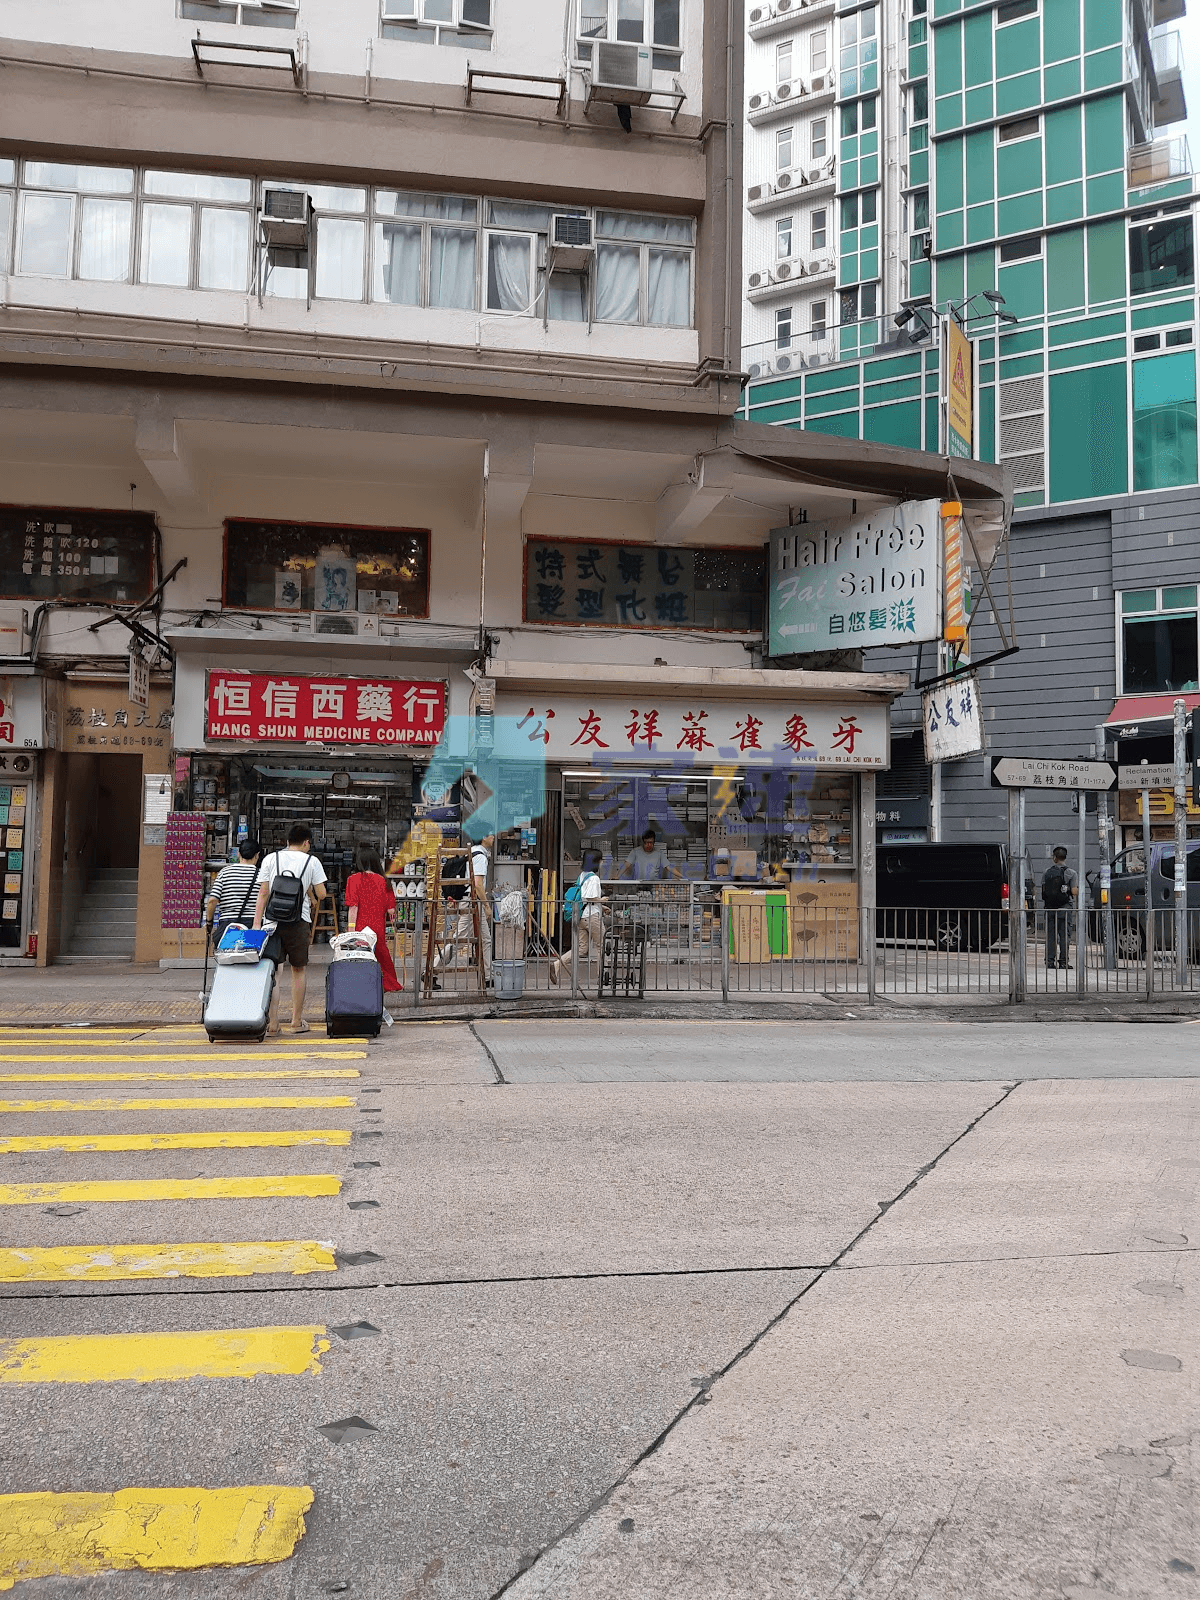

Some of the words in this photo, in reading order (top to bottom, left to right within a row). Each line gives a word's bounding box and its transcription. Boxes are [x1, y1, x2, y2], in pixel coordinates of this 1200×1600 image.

[76, 538, 99, 548] 120
[778, 530, 842, 570] Hair
[856, 523, 925, 559] Free
[59, 553, 81, 562] 100
[840, 568, 925, 597] Salon
[213, 679, 440, 724] 恒信西藥行
[928, 686, 973, 732] 公友祥
[211, 722, 250, 737] HANG
[258, 724, 297, 738] SHUN
[303, 726, 371, 740] MEDICINE
[376, 728, 443, 743] COMPANY
[24, 739, 38, 748] 65A
[1022, 762, 1035, 770] Lai
[1036, 762, 1050, 770] Chi
[1051, 762, 1066, 771] Kok
[1068, 763, 1090, 772] Road
[1125, 767, 1172, 775] Reclamation
[1007, 774, 1027, 782] 57-69
[1033, 774, 1079, 786] 荔枝角道
[1083, 777, 1107, 785] 71-117A
[1140, 776, 1172, 785] 新填地
[875, 811, 901, 821] 物料
